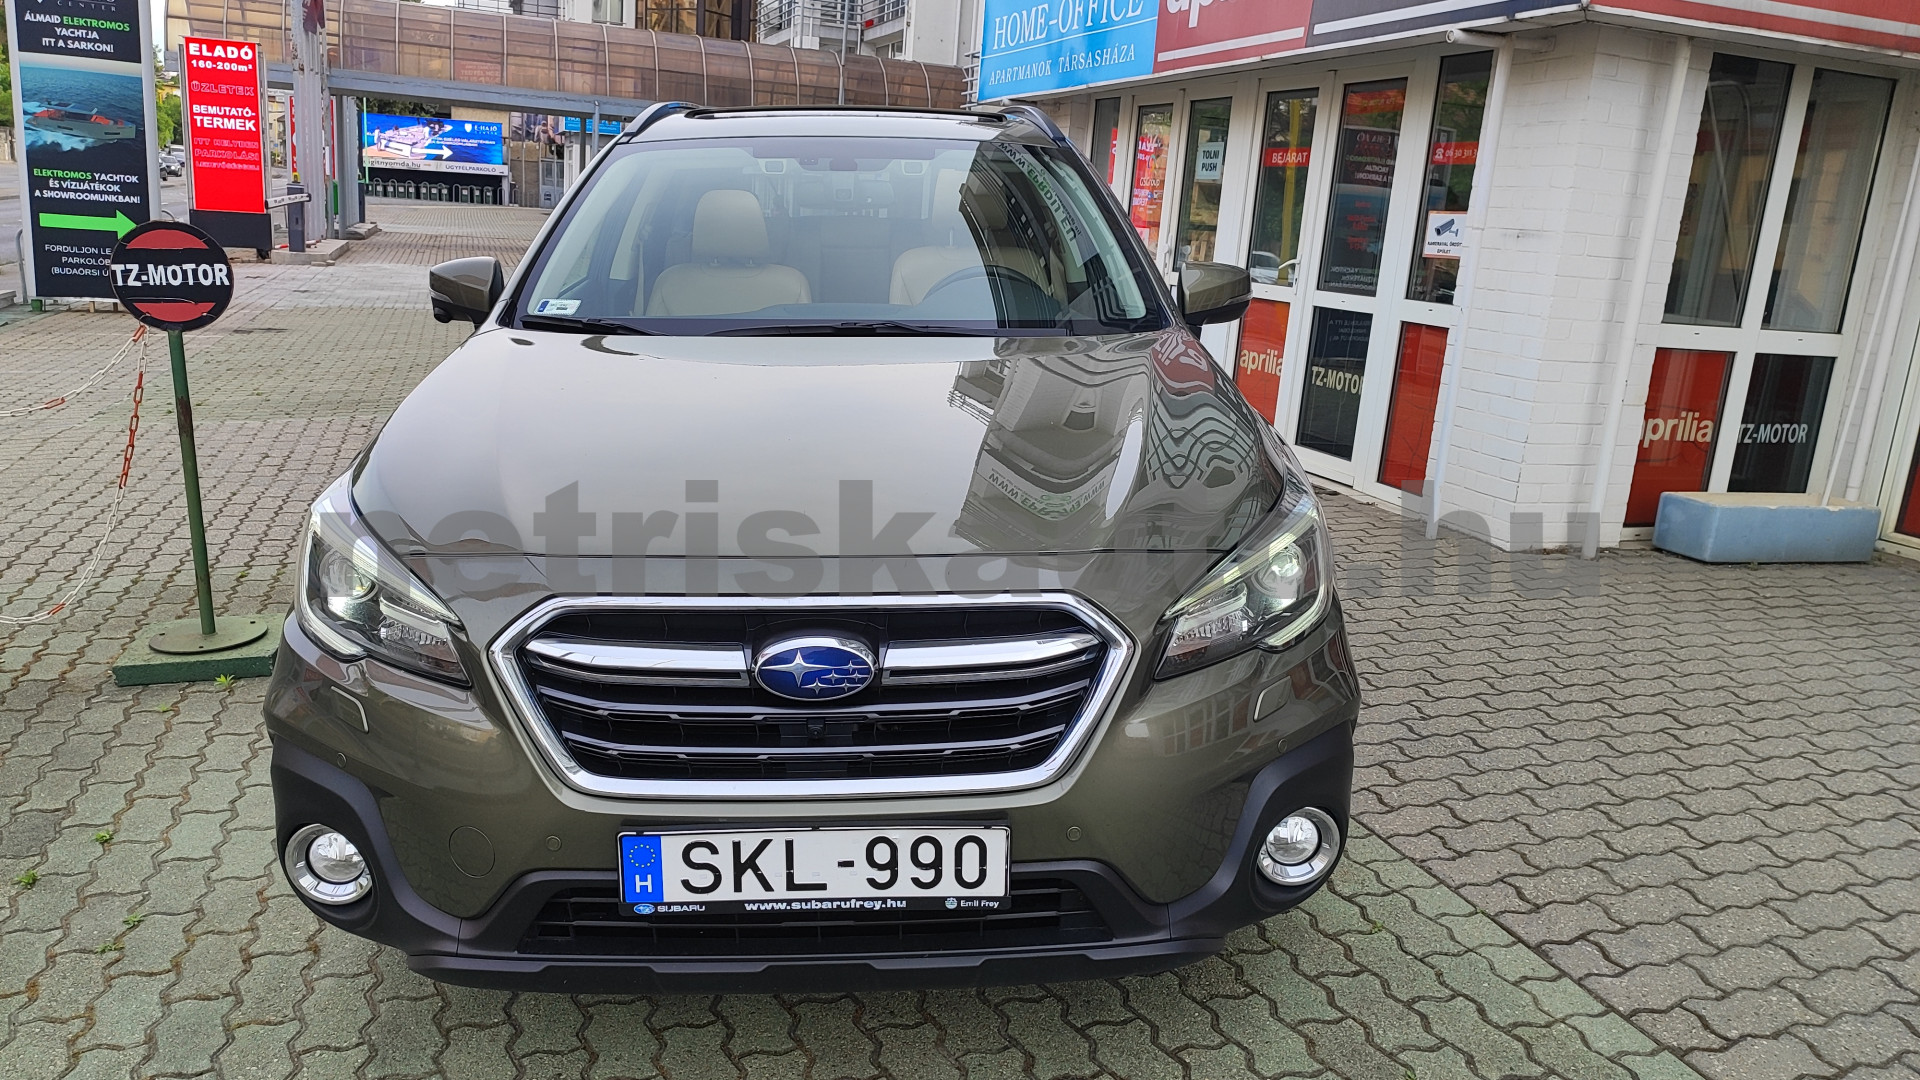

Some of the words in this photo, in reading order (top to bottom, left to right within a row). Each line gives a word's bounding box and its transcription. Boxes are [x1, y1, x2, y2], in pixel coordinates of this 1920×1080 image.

[57, 0, 117, 12] CENTER
[24, 10, 62, 24] ÁLMAID
[63, 16, 131, 32] ELEKTROMOS
[992, 0, 1144, 50] HOME-OFFICE
[54, 27, 100, 40] YACHTJA
[42, 37, 56, 47] ITT
[57, 39, 66, 48] A
[67, 40, 114, 53] SARKON!
[188, 43, 253, 60] ELADÓ
[989, 59, 1053, 86] APARTMANOK
[1058, 43, 1136, 74] TÁRSASHÁZA
[192, 104, 256, 117] BEMUTATÓ-
[193, 116, 257, 132] TERMEK
[1202, 149, 1220, 160] TOLNI
[1271, 150, 1308, 163] BEJÁRAT
[1200, 162, 1218, 172] PUSH
[33, 168, 92, 180] ELEKTROMOS
[93, 172, 140, 183] YACHTOK
[48, 178, 60, 188] ÉS
[34, 189, 42, 197] A
[42, 189, 141, 203] SHOWROOMUNKBAN!
[44, 244, 99, 254] FORDULJON
[100, 247, 112, 255] LE
[110, 263, 230, 287] TZ-MOTOR
[1239, 348, 1284, 377] aprilia
[1640, 411, 1715, 448] prilia
[680, 834, 988, 895] SKL-990
[635, 874, 653, 893] H
[656, 904, 706, 913] SUBARU
[743, 898, 907, 911] www.subarufrey.hu
[960, 899, 979, 908] Emil
[980, 899, 1000, 909] Frey
